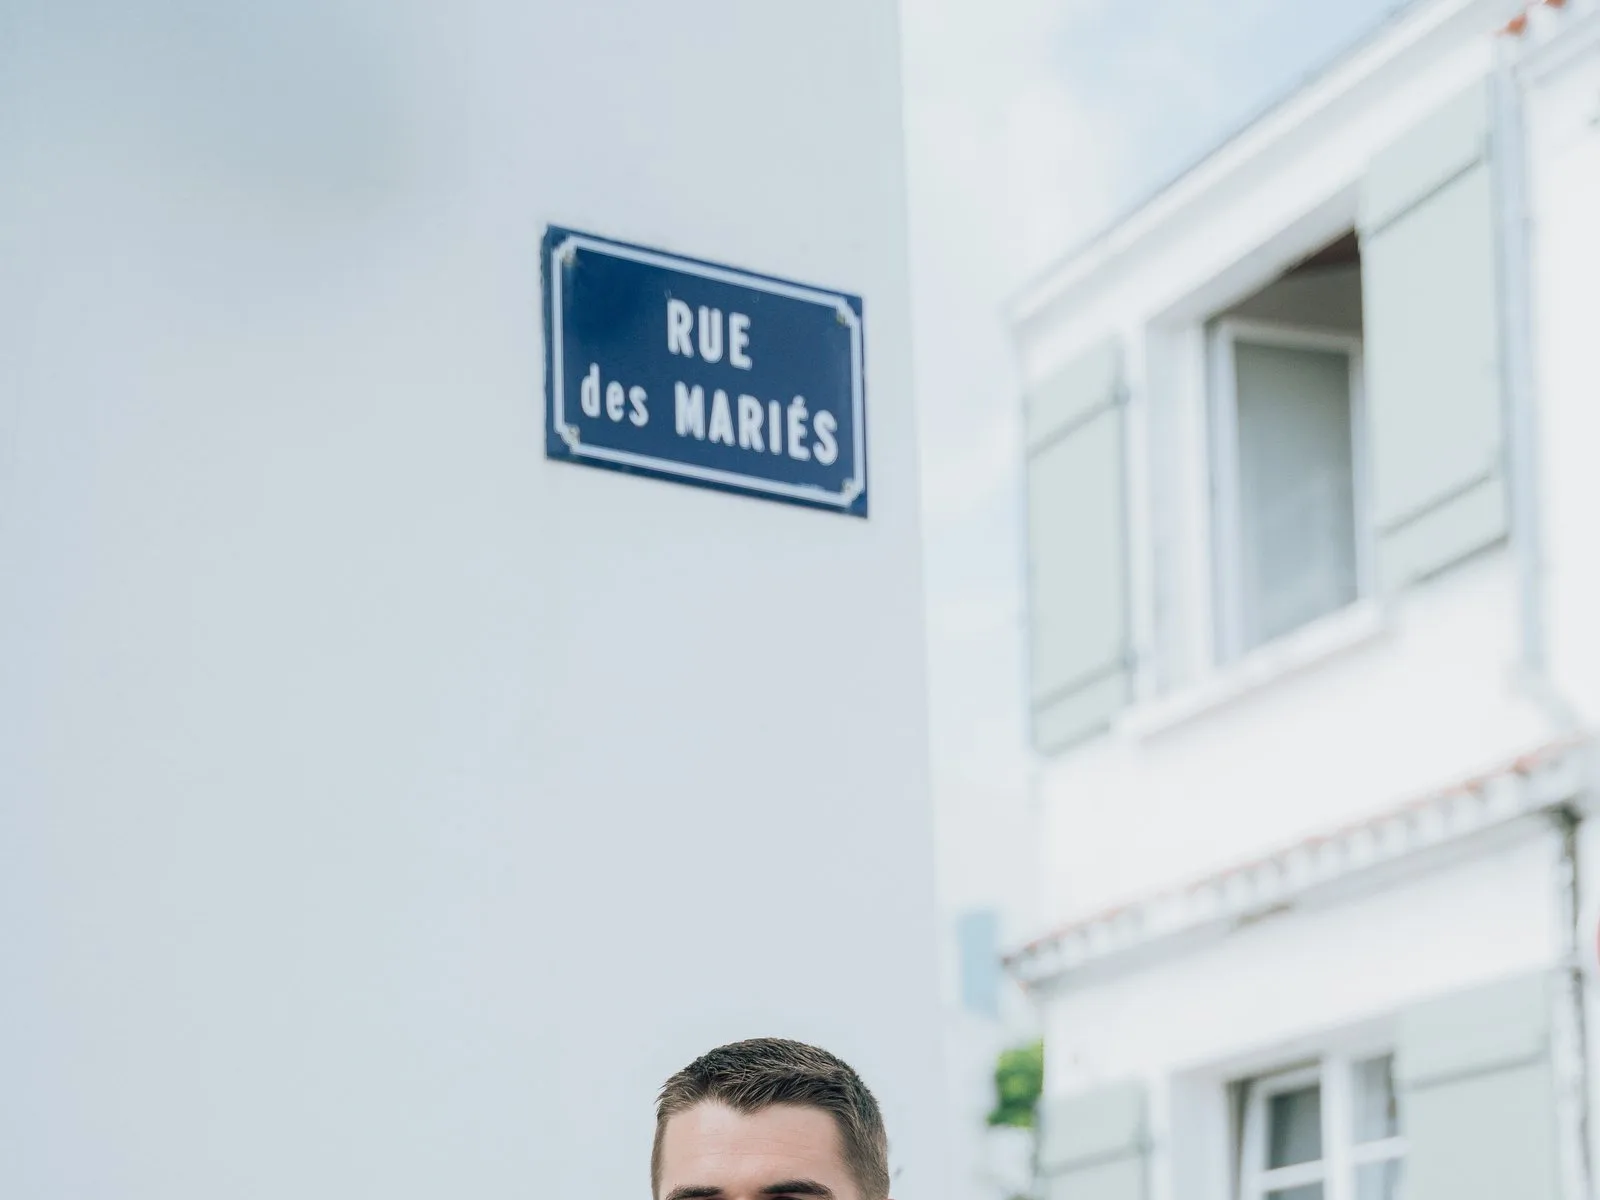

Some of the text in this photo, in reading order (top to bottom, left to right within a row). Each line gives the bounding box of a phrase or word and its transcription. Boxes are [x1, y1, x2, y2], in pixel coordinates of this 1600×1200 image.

[667, 298, 752, 370] RUE
[580, 362, 839, 465] des MARIÉS
